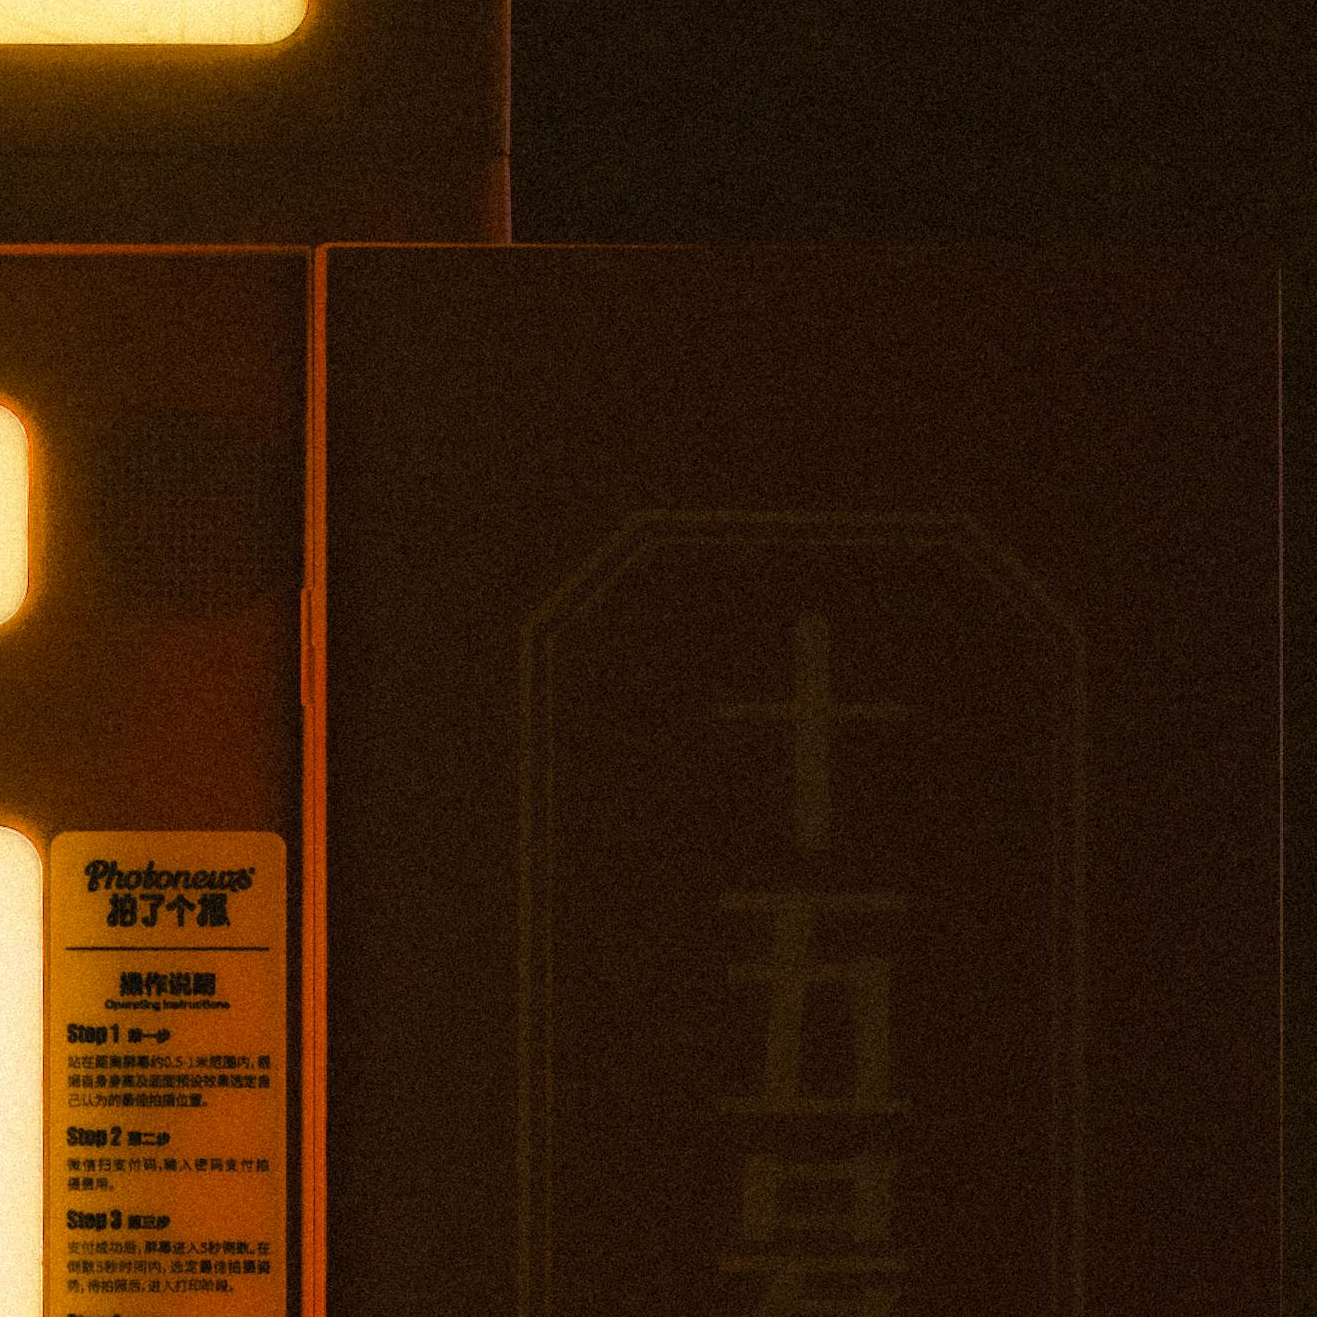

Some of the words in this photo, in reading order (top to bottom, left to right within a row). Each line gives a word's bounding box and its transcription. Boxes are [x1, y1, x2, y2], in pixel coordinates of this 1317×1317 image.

[107, 893, 230, 927] 拍了个报
[120, 972, 216, 996] 操作说明
[67, 1024, 107, 1045] Step
[110, 1024, 120, 1043] 1
[128, 1028, 170, 1044] 第一步
[67, 1126, 107, 1147] Step
[110, 1126, 122, 1146] 2
[128, 1131, 170, 1146] 第二步
[67, 1209, 107, 1231] Step
[110, 1209, 122, 1229] 3
[128, 1214, 170, 1229] 第三步
